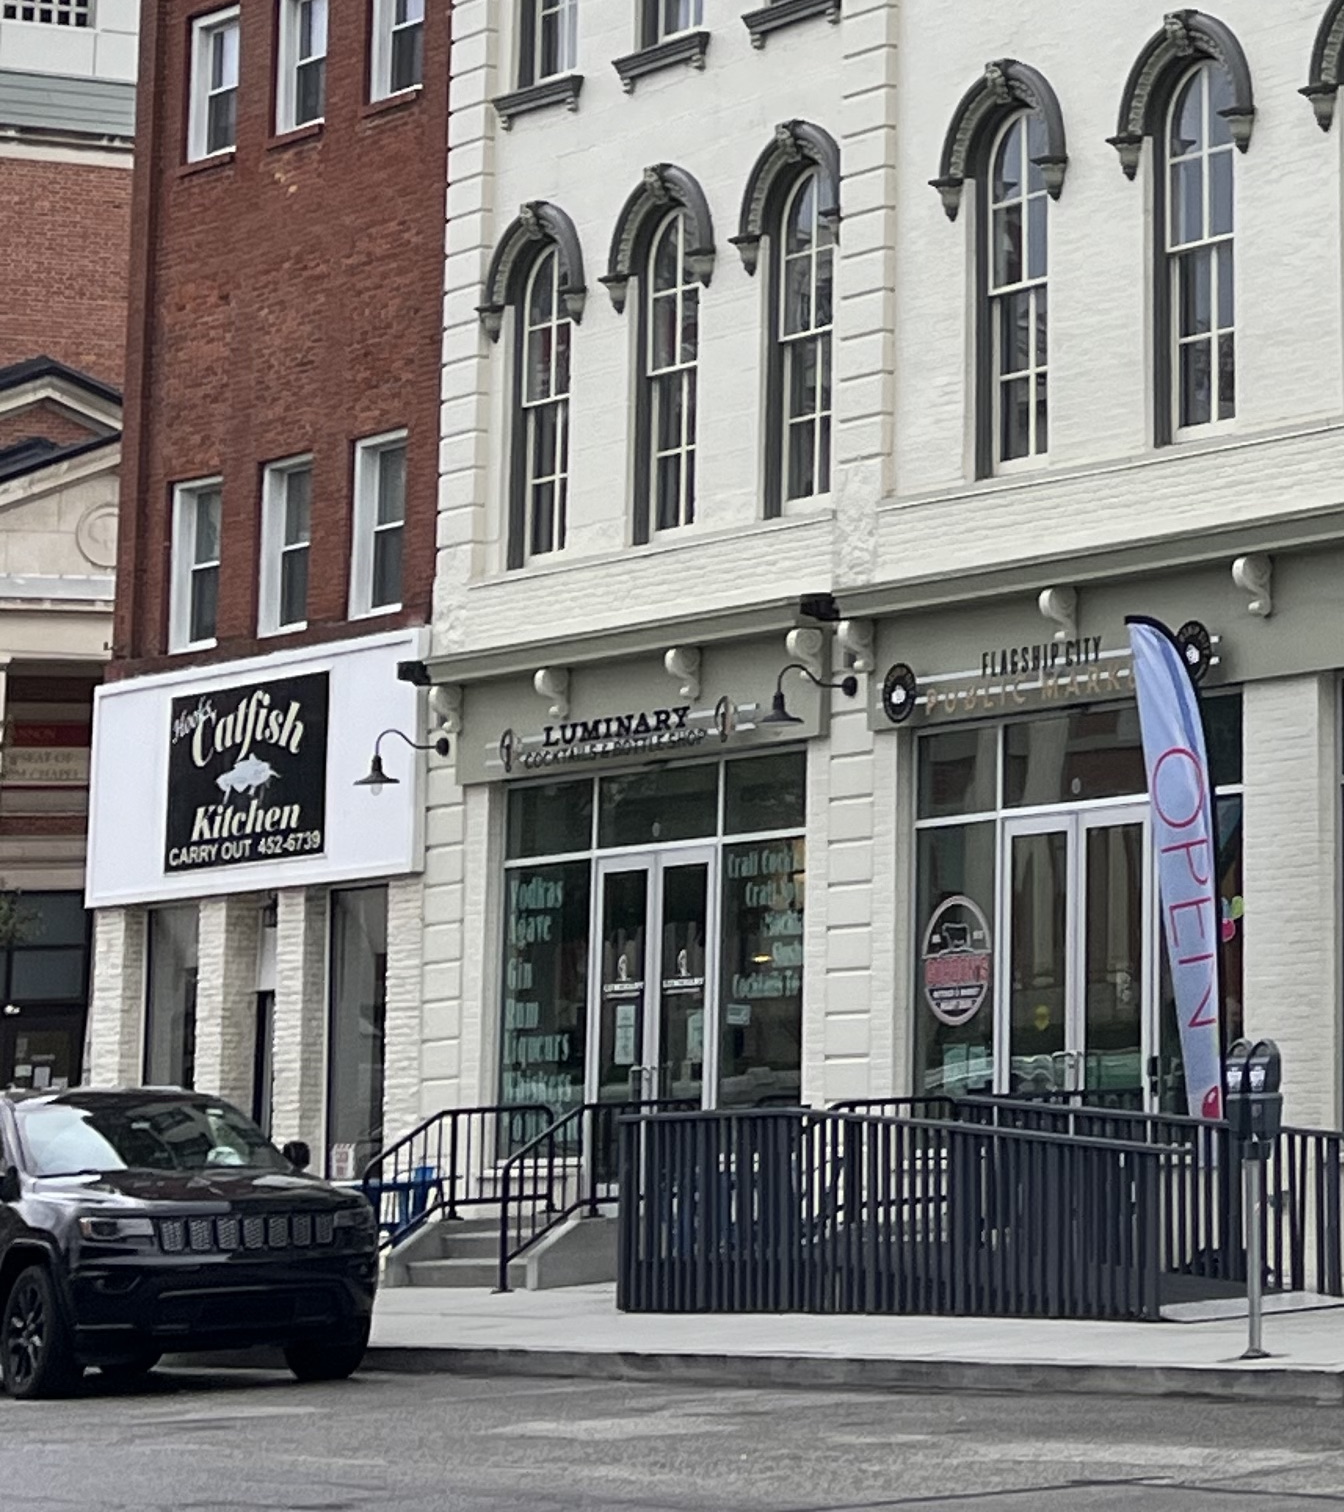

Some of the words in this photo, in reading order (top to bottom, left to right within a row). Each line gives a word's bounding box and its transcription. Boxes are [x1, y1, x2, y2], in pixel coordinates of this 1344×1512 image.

[981, 645, 1058, 680] FLAGSHIP
[1064, 635, 1103, 668] CITY
[924, 676, 1026, 716] PUBLIC
[1040, 660, 1135, 701] MARK
[191, 689, 305, 768] Catfish
[542, 705, 691, 748] LUMINARY
[190, 798, 301, 843] Kitchen
[168, 844, 219, 867] CARRY
[221, 838, 253, 860] OUT
[257, 829, 322, 855] 452-6739
[1151, 746, 1218, 1030] OPEN
